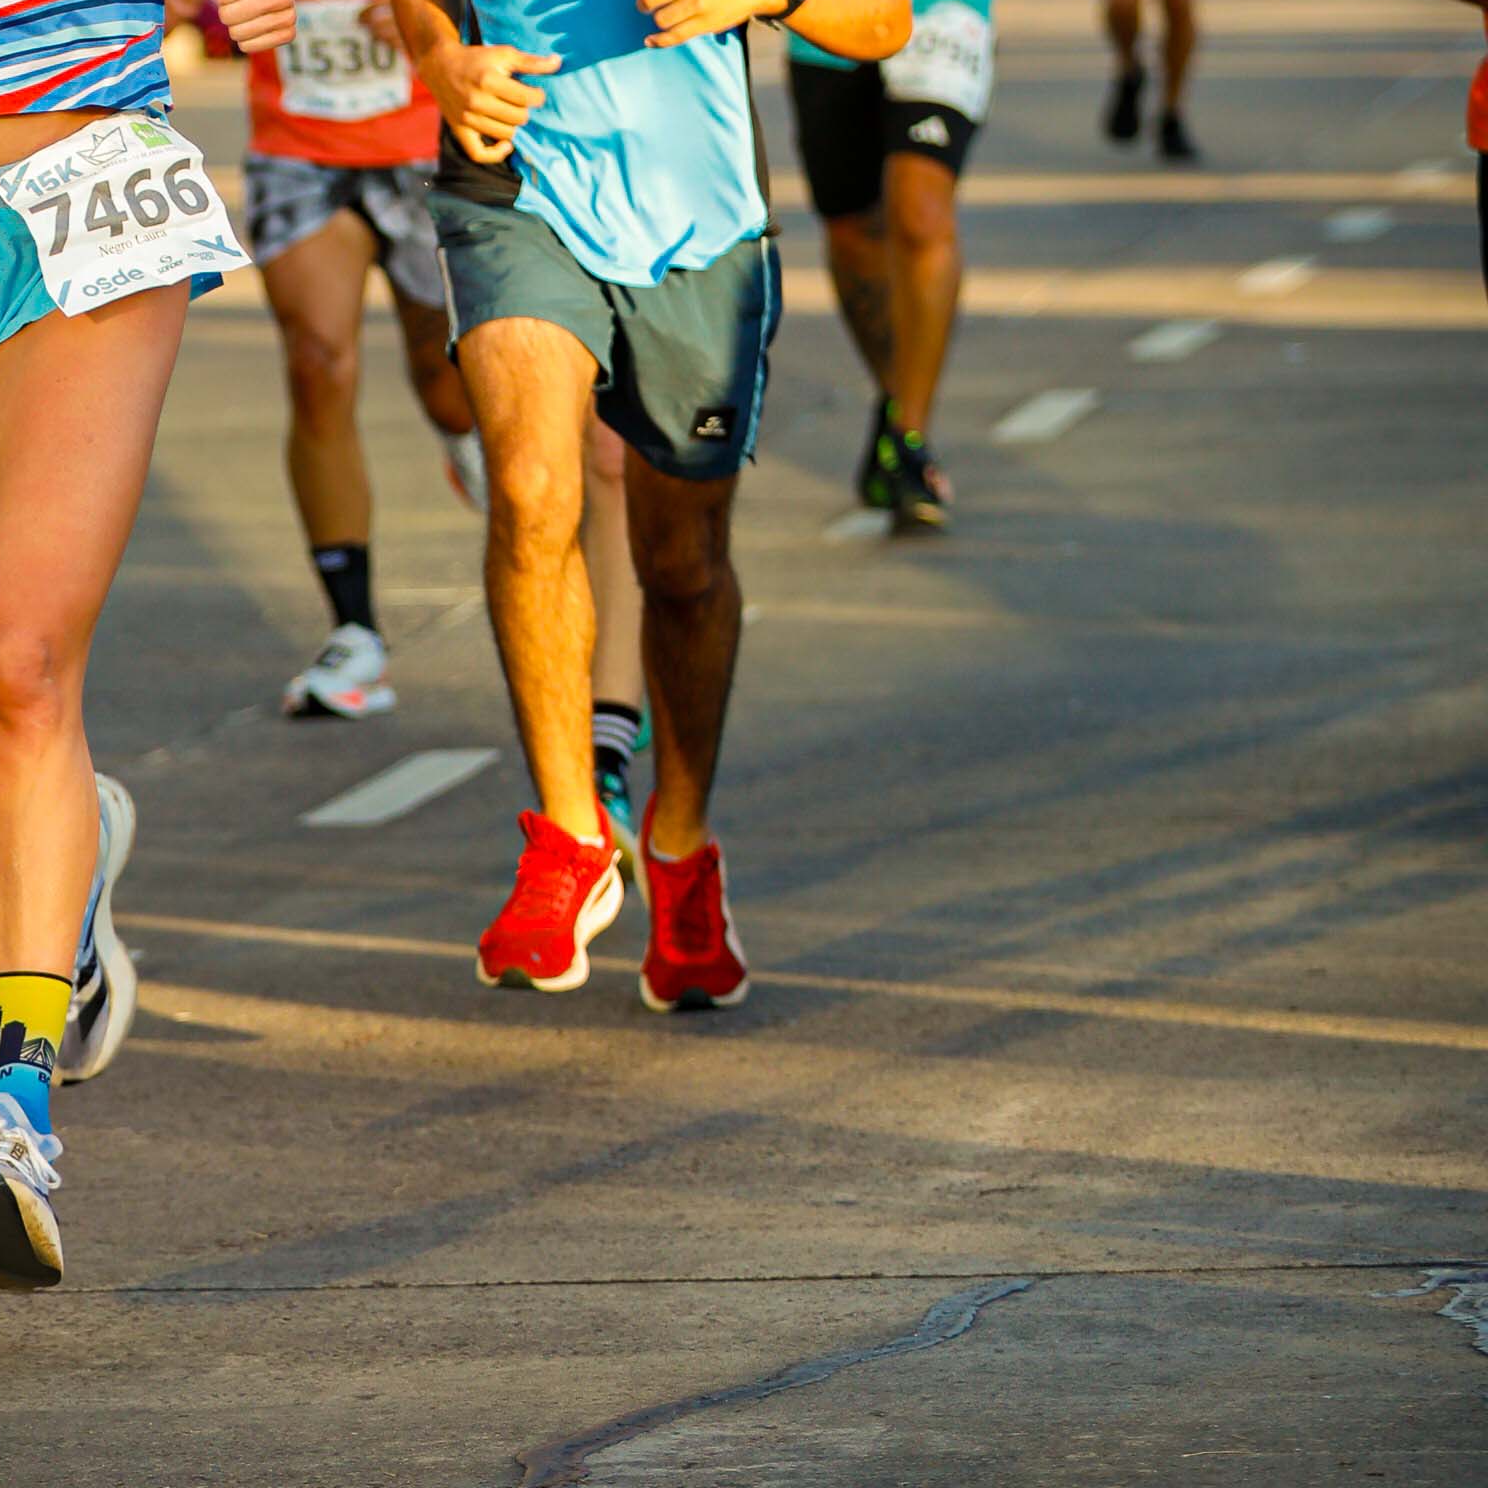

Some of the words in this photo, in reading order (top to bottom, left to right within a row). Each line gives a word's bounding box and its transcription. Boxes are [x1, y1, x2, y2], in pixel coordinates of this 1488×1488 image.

[286, 37, 396, 76] 1530
[25, 157, 83, 197] 15K
[29, 158, 210, 257] 7466
[98, 239, 133, 258] Negro
[135, 229, 168, 246] Laura
[82, 266, 145, 299] osde
